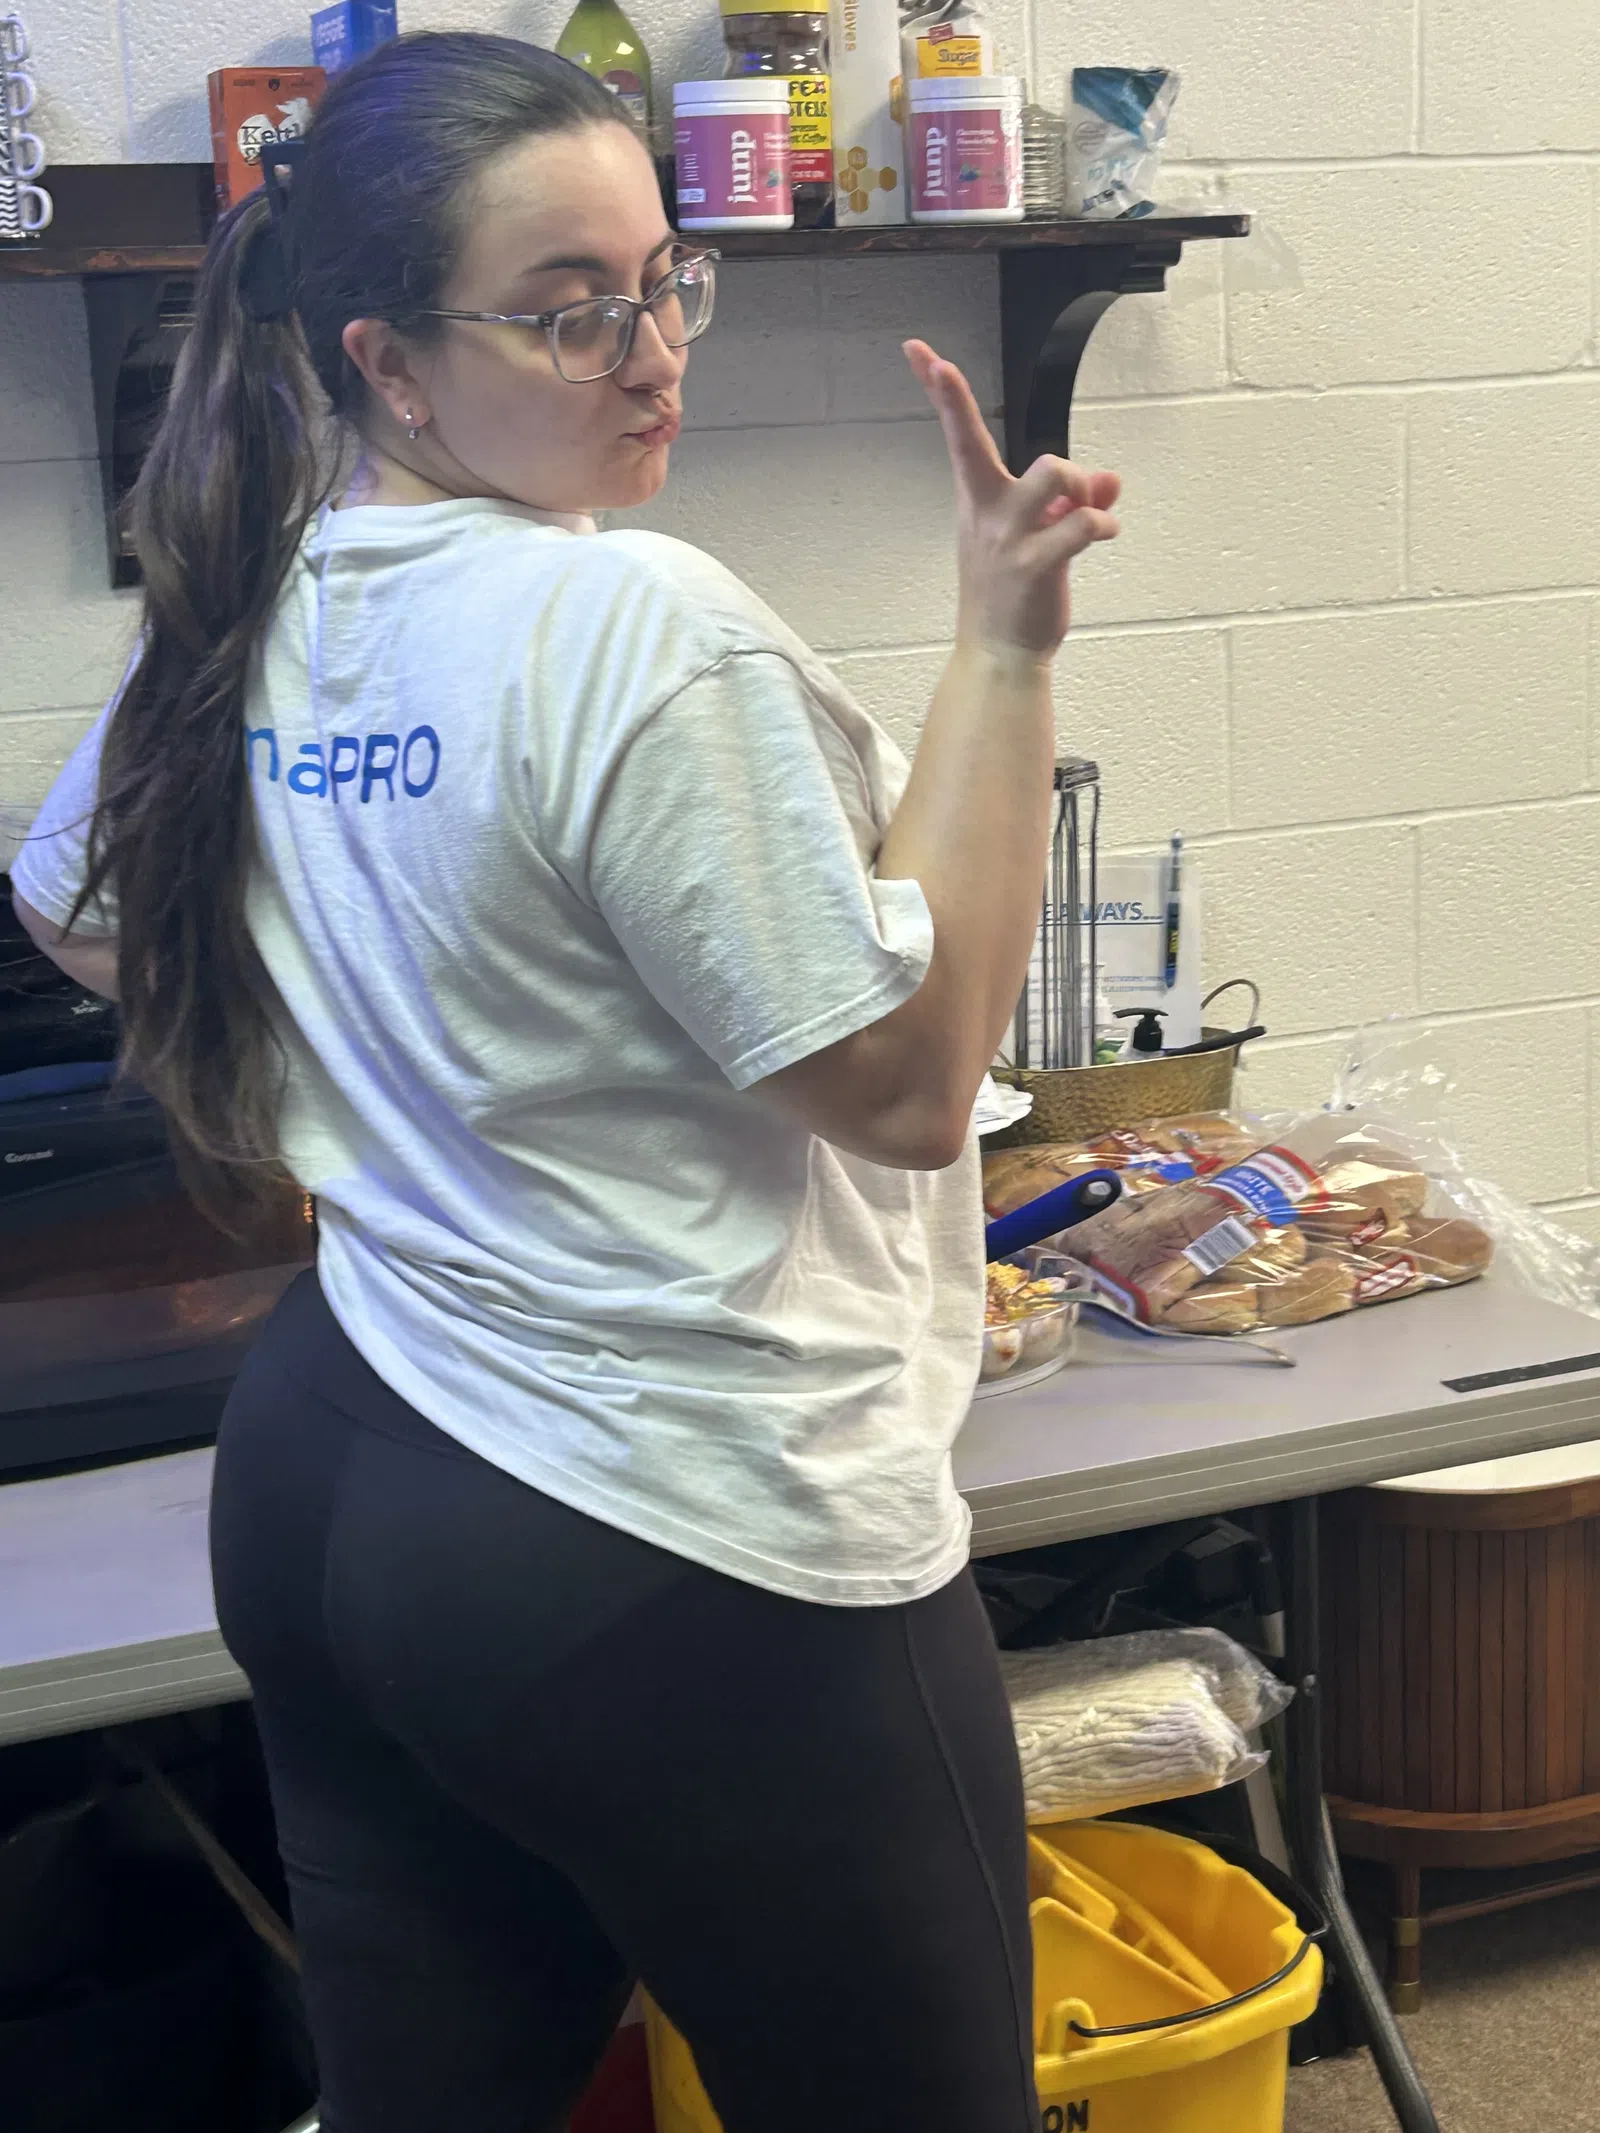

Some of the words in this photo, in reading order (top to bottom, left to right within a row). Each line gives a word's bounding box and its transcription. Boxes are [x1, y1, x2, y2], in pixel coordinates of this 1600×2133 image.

[726, 130, 758, 203] jump
[922, 127, 948, 197] jump
[1042, 2099, 1089, 2133] ON
